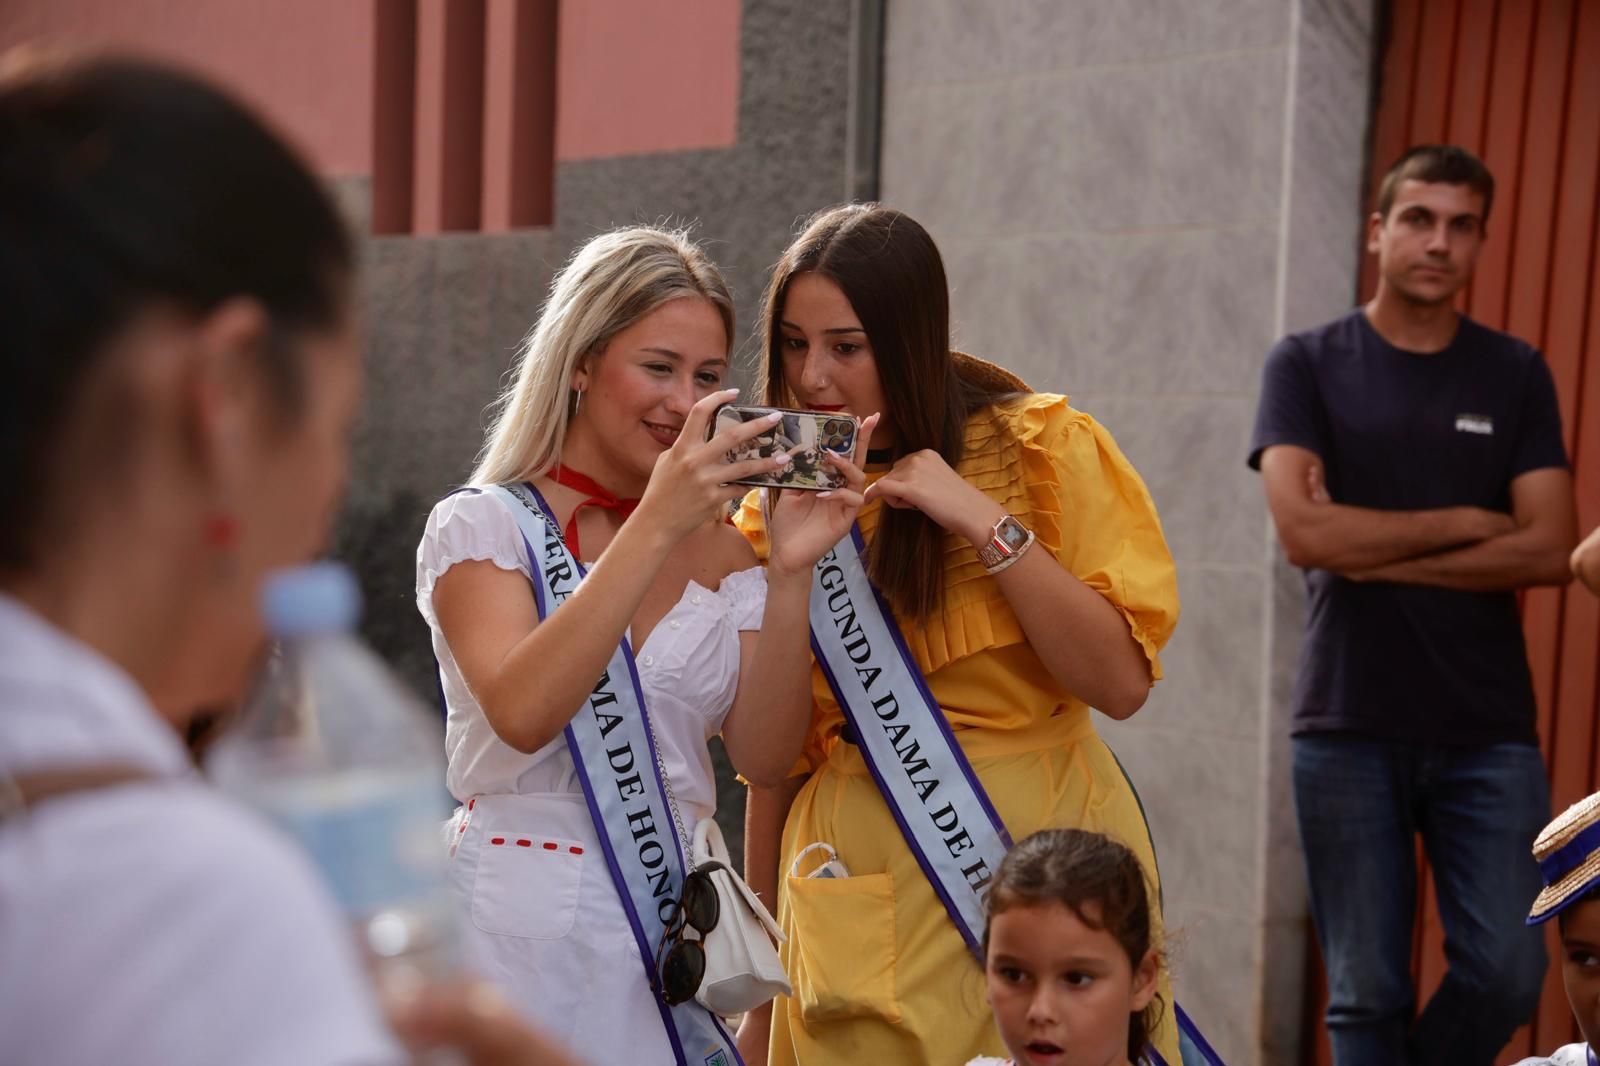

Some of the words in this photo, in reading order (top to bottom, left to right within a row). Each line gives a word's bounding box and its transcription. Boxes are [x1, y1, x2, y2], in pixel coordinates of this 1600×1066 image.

[589, 669, 624, 741] MA
[816, 547, 882, 694] EGUNDA
[871, 689, 941, 805] DAMA
[929, 801, 975, 859] DE
[960, 856, 992, 895] H
[605, 740, 646, 803] DE
[626, 804, 677, 942] HONO
